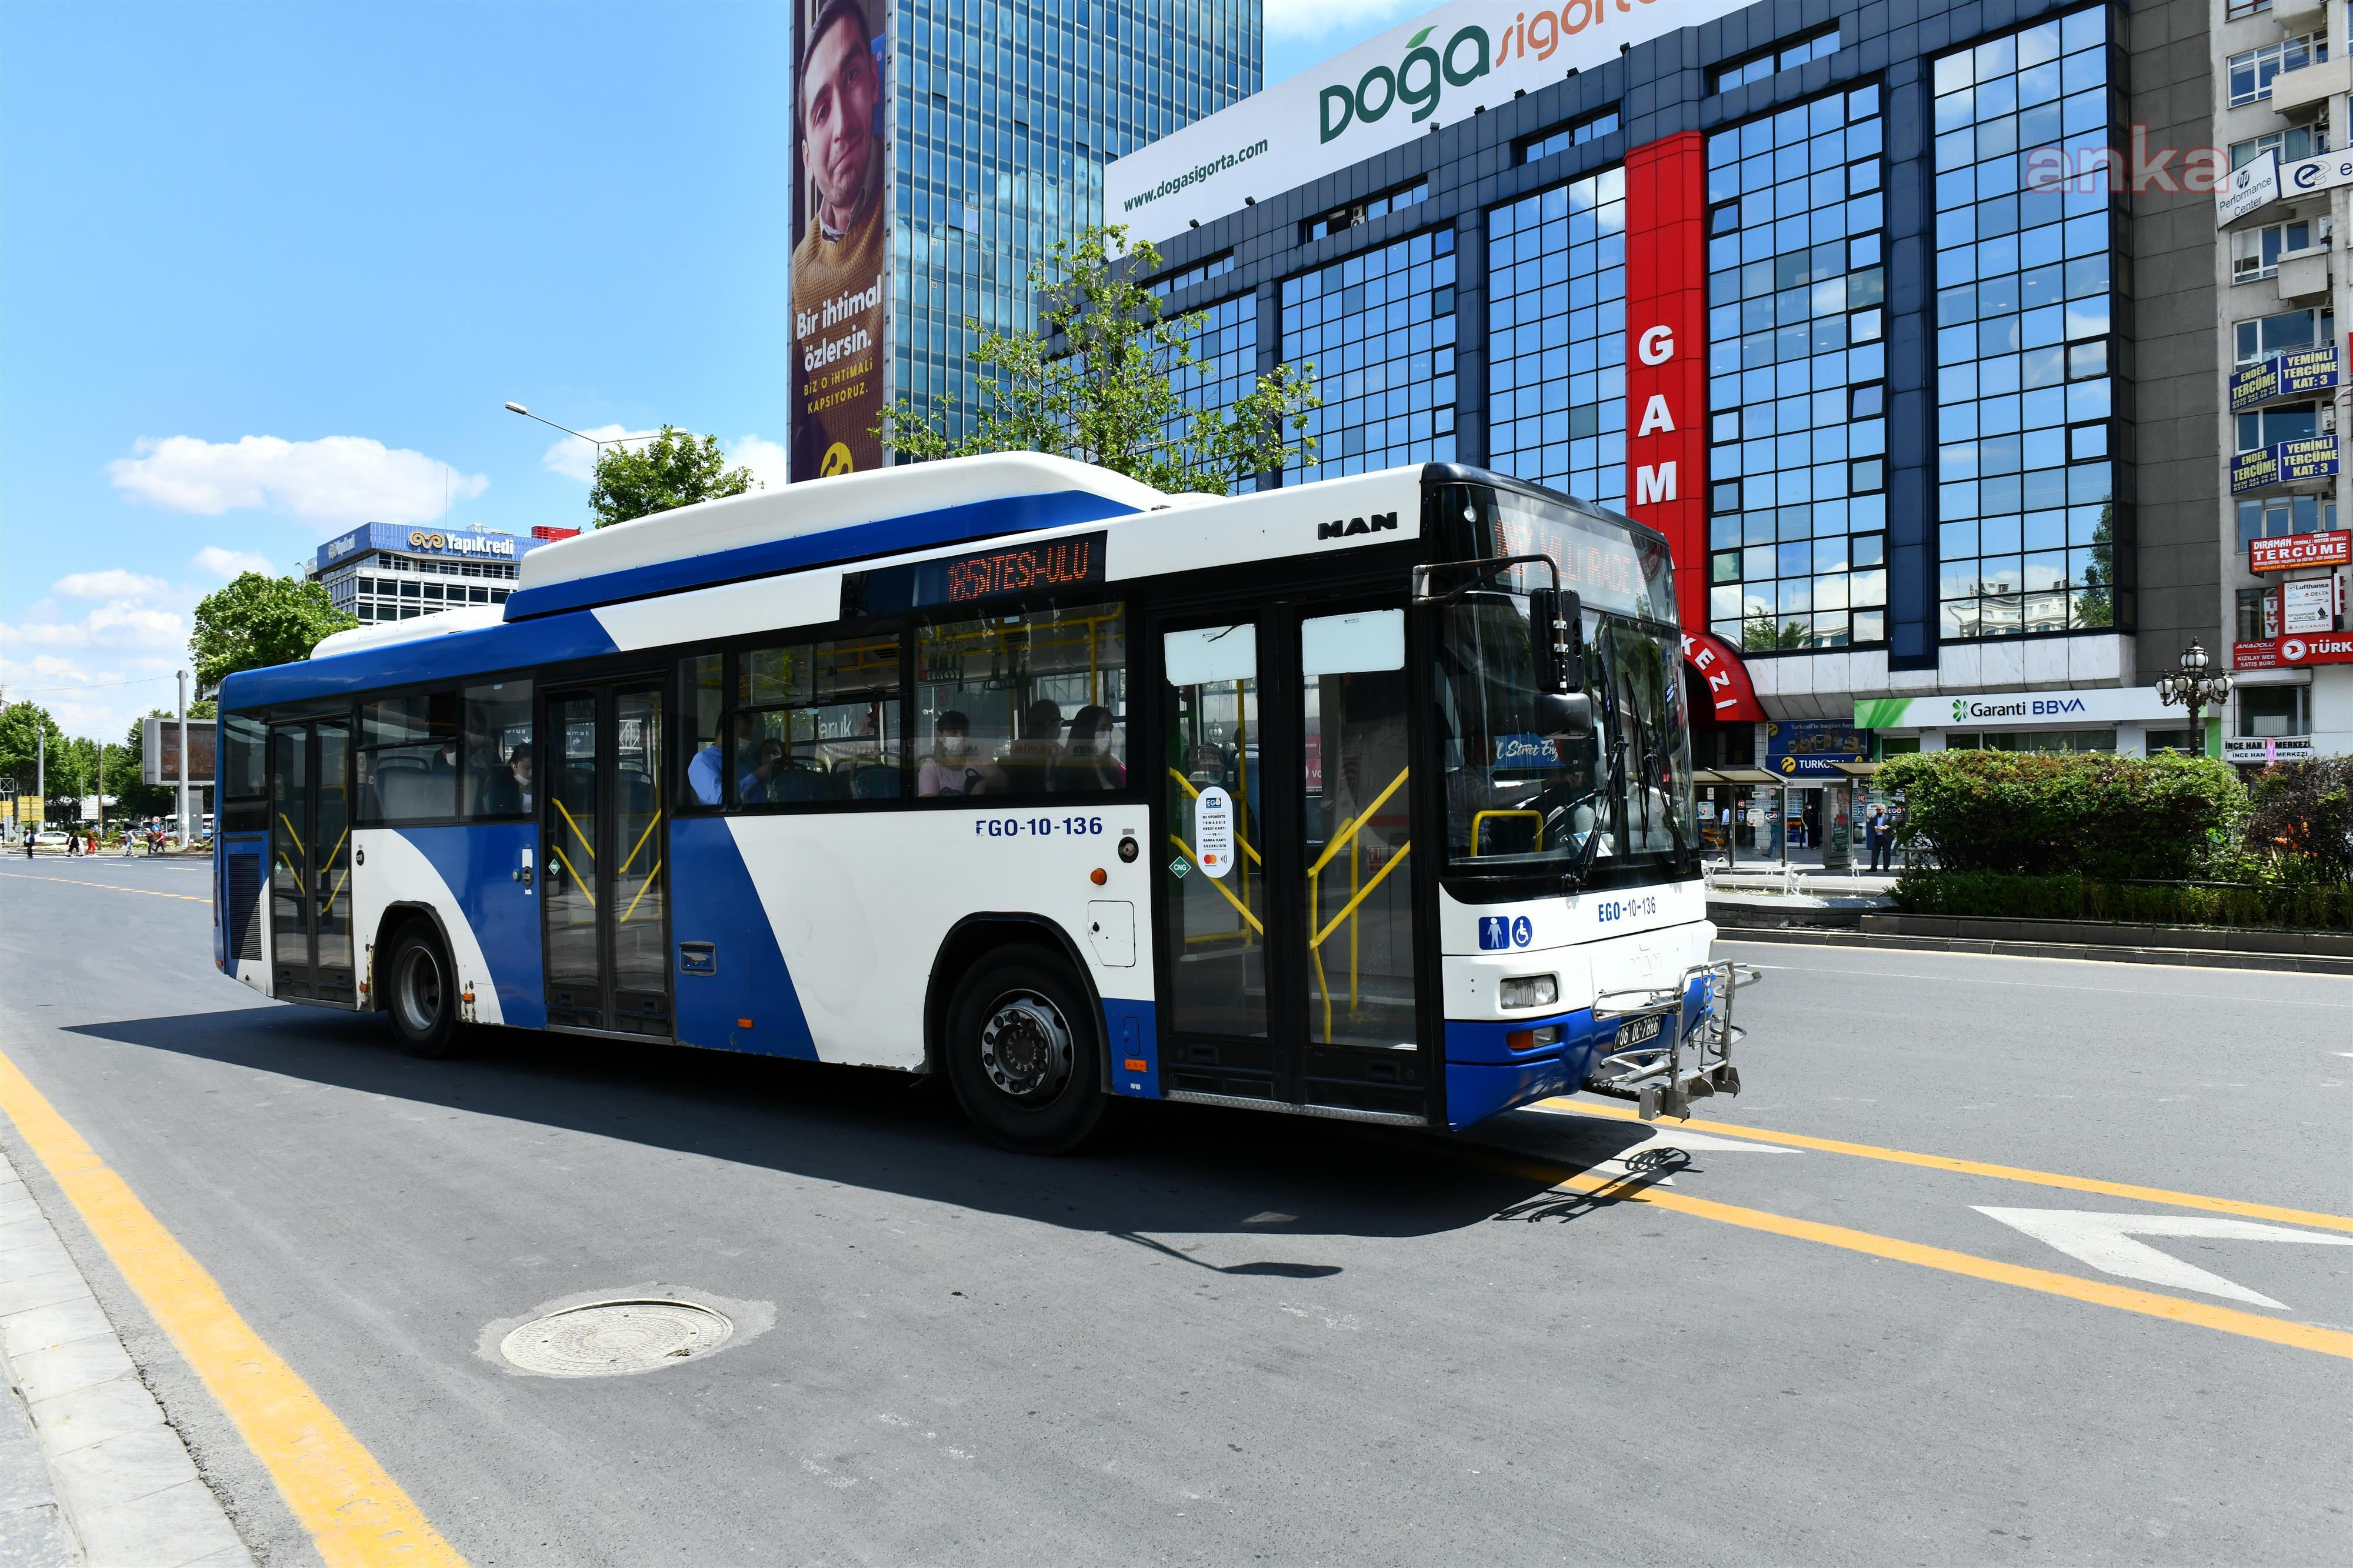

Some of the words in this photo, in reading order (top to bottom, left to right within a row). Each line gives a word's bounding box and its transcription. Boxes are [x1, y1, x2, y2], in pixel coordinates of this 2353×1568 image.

[1123, 137, 1269, 212] www.dogasigorta.com
[2219, 177, 2272, 212] Performance
[2234, 196, 2262, 216] Center
[796, 310, 821, 341] Bir
[822, 274, 882, 328] ihtimal
[805, 325, 872, 372] özlersin.
[2287, 348, 2334, 367] YEMİNLİ
[2241, 364, 2267, 382] ENDER
[2283, 361, 2338, 379] TERCÜME
[821, 377, 828, 391] O
[2232, 372, 2277, 400] TERCÜME
[2292, 376, 2318, 389] KAT:
[2320, 375, 2328, 385] 3
[807, 387, 869, 414] KAPSIYORUZ.
[2232, 396, 2247, 405] 0530
[2232, 401, 2247, 409] 0312
[1635, 322, 1678, 506] GAM
[2287, 437, 2333, 454] YEMİNLİ
[2241, 450, 2267, 466] ENDER
[2283, 449, 2338, 466] TERCÜME
[2233, 458, 2277, 482] TERCÜME
[2292, 465, 2318, 477] KAT:
[2320, 462, 2328, 473] 3
[1317, 512, 1399, 541] MAN
[2254, 538, 2292, 550] DIRAMAN
[2254, 542, 2347, 561] TERCÜME
[2309, 639, 2353, 654] TÜRK
[1970, 700, 2027, 719] Garanti
[2032, 698, 2085, 715] BBVA
[1507, 740, 1539, 758] Street
[2225, 741, 2244, 749] İNCE
[2275, 739, 2311, 749] MERKEZİ
[1174, 863, 1187, 872] CNG
[1598, 896, 1657, 922] EGO-10-136
